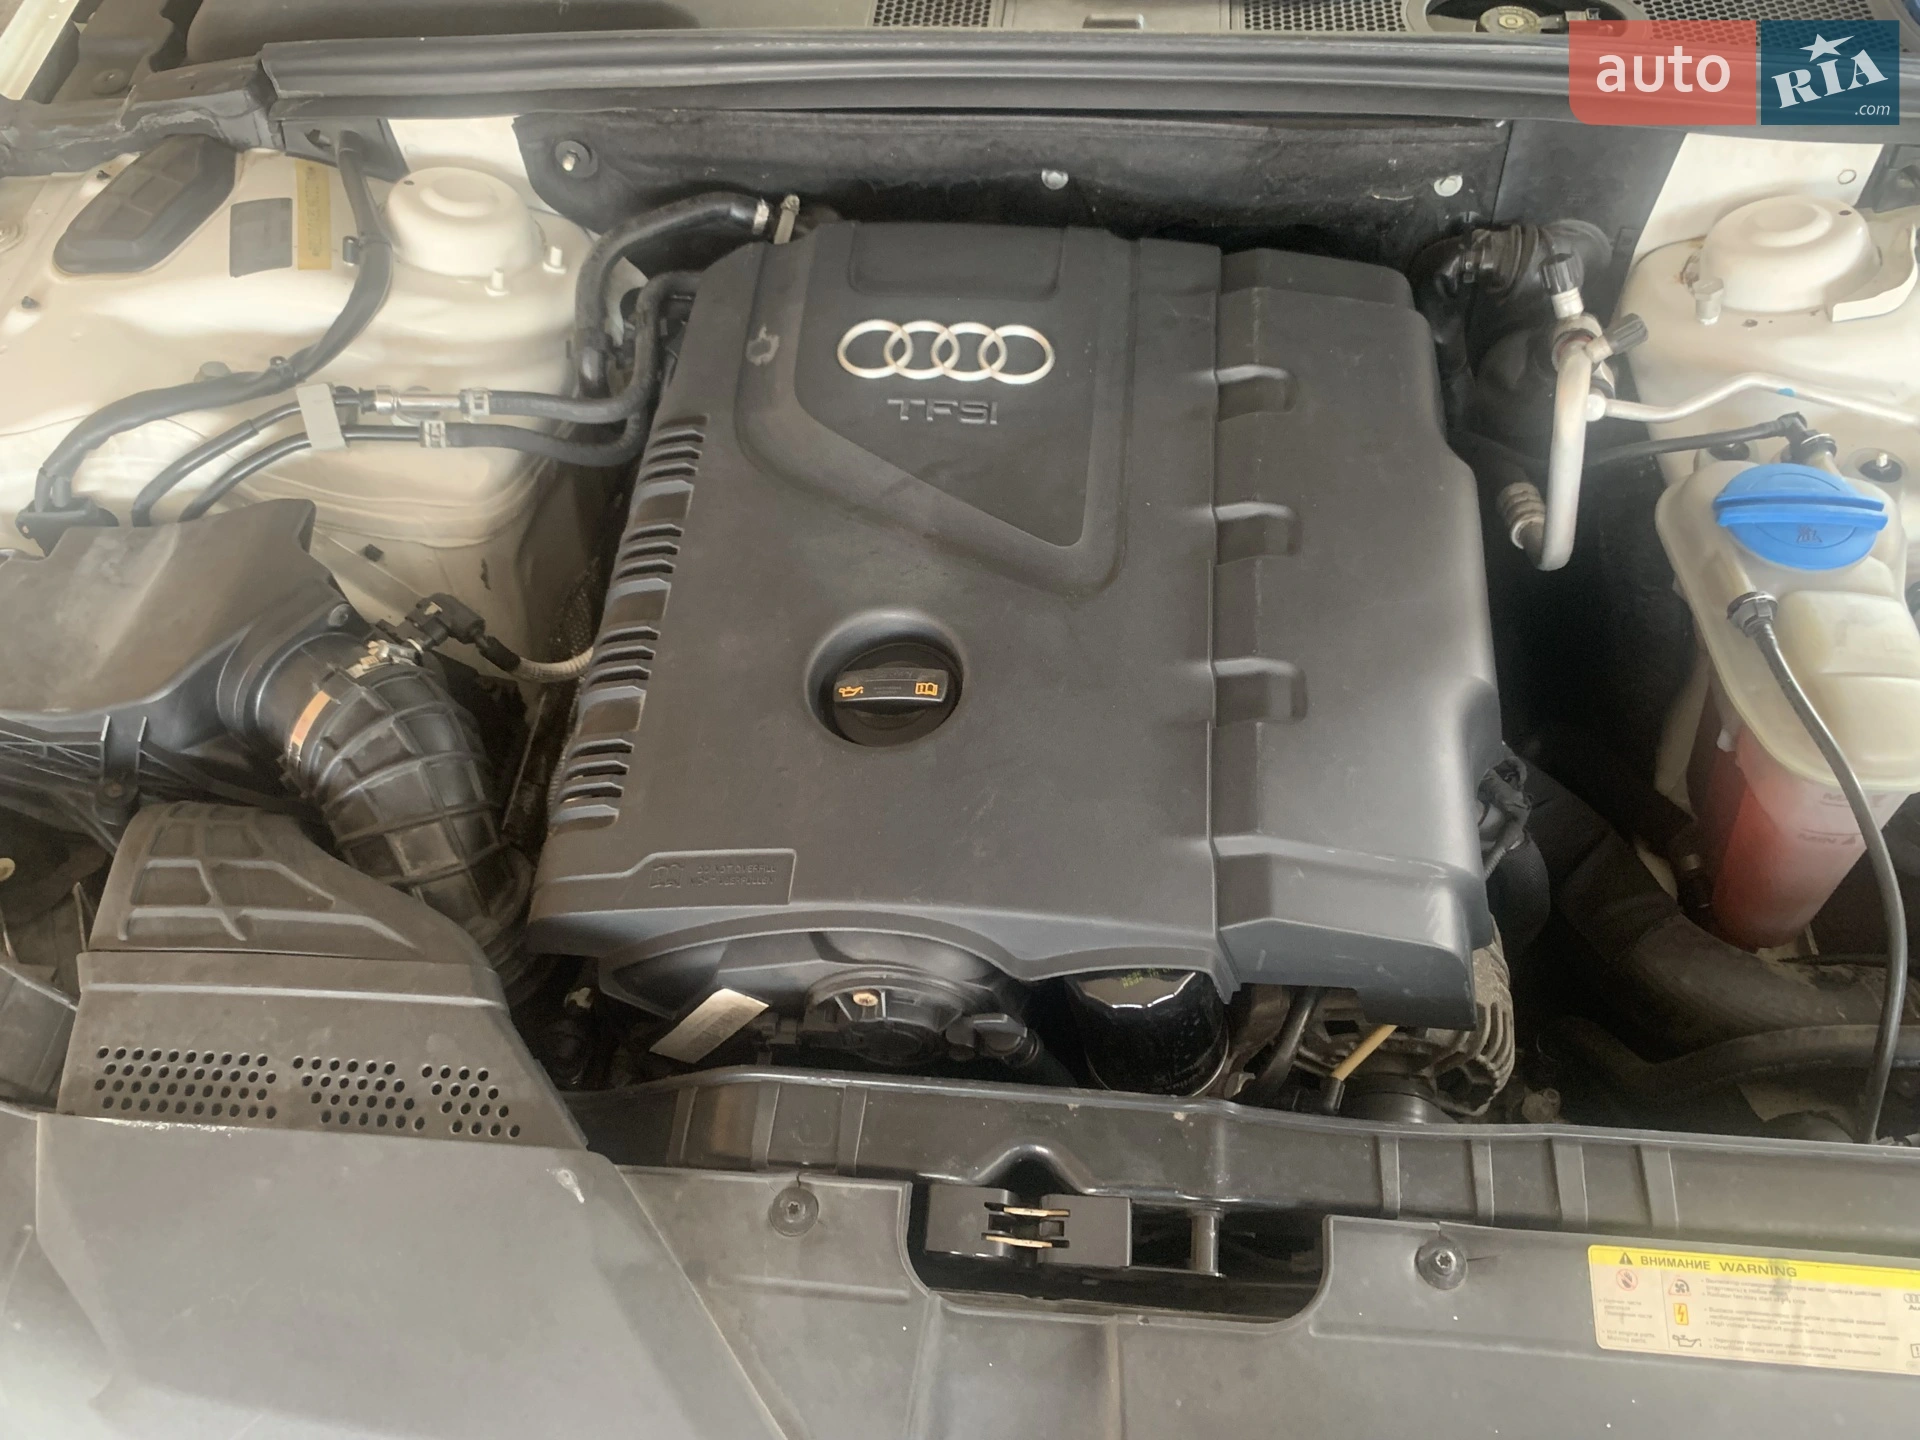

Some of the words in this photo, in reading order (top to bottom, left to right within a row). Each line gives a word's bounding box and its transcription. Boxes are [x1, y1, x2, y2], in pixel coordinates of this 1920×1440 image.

[887, 399, 998, 425] TFSI
[735, 863, 777, 875] OVERFILL
[1640, 1255, 1711, 1270] ВНИМАНИЕ
[1719, 1261, 1797, 1277] WARNING
